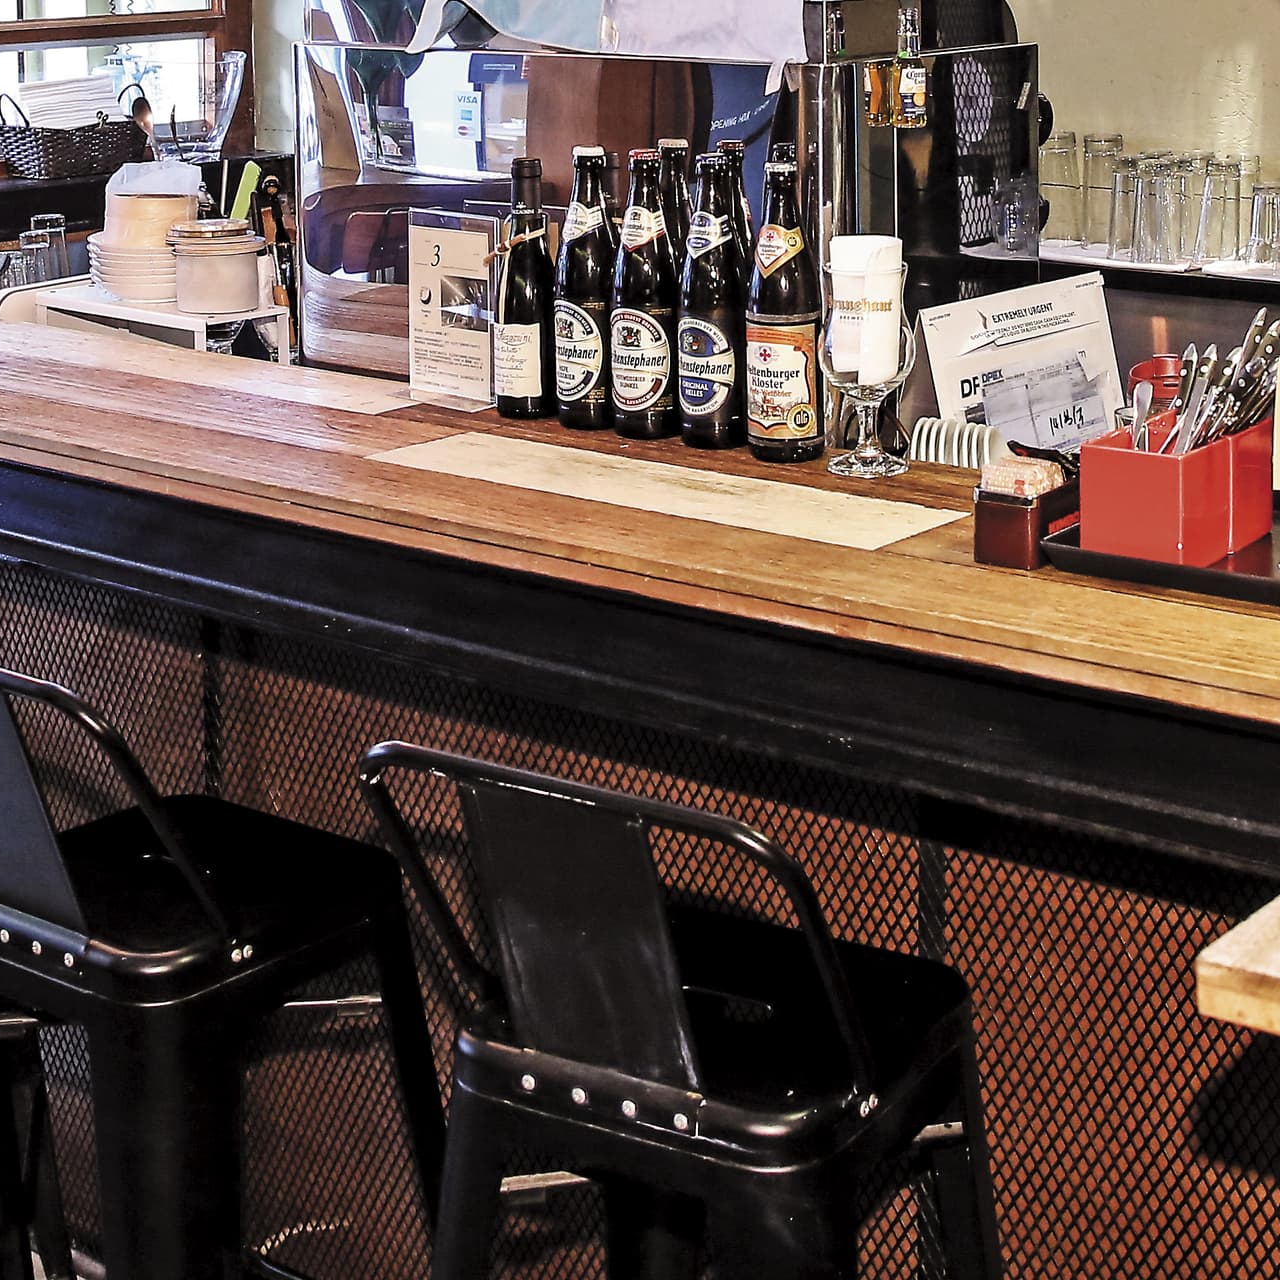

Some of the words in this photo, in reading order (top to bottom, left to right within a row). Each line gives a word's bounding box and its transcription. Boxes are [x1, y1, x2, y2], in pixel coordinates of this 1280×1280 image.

[457, 96, 478, 104] VISA
[430, 244, 441, 267] 3
[991, 308, 1028, 324] EXTREMELY
[1028, 302, 1054, 317] URGENT
[613, 350, 667, 369] henstephaner
[682, 380, 708, 391] ORIGINAL
[752, 377, 785, 389] Kloster
[960, 376, 980, 399] DP
[686, 388, 703, 397] HELLES
